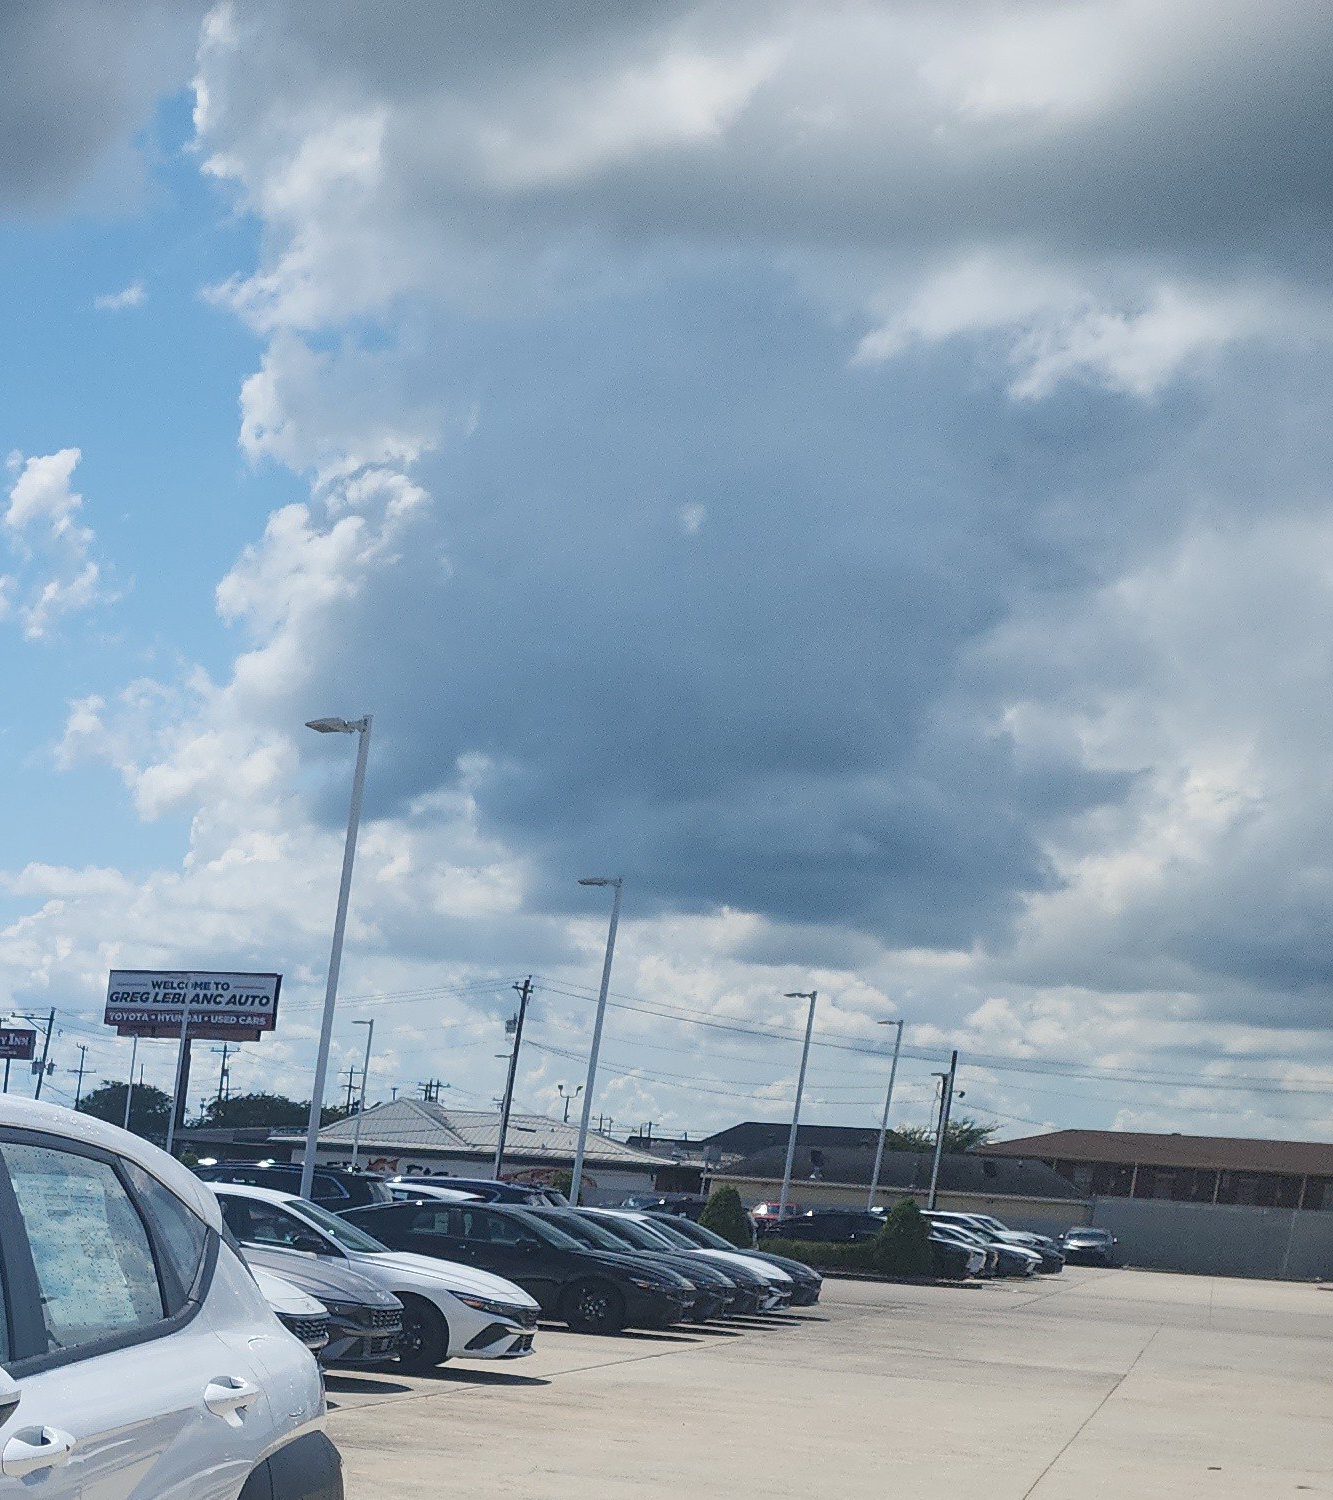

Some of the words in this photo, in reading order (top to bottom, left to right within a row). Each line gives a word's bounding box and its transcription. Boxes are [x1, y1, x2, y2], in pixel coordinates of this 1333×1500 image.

[151, 980, 212, 991] WELCOME
[214, 981, 231, 991] TO
[109, 991, 150, 1004] GREG
[152, 992, 225, 1006] LEBLANC
[225, 993, 271, 1008] AUTO
[109, 1012, 149, 1022] TOYOTA
[157, 1013, 202, 1023] HYUNDAI
[210, 1016, 237, 1025] USED
[238, 1016, 266, 1025] CARS
[8, 1032, 29, 1046] INN
